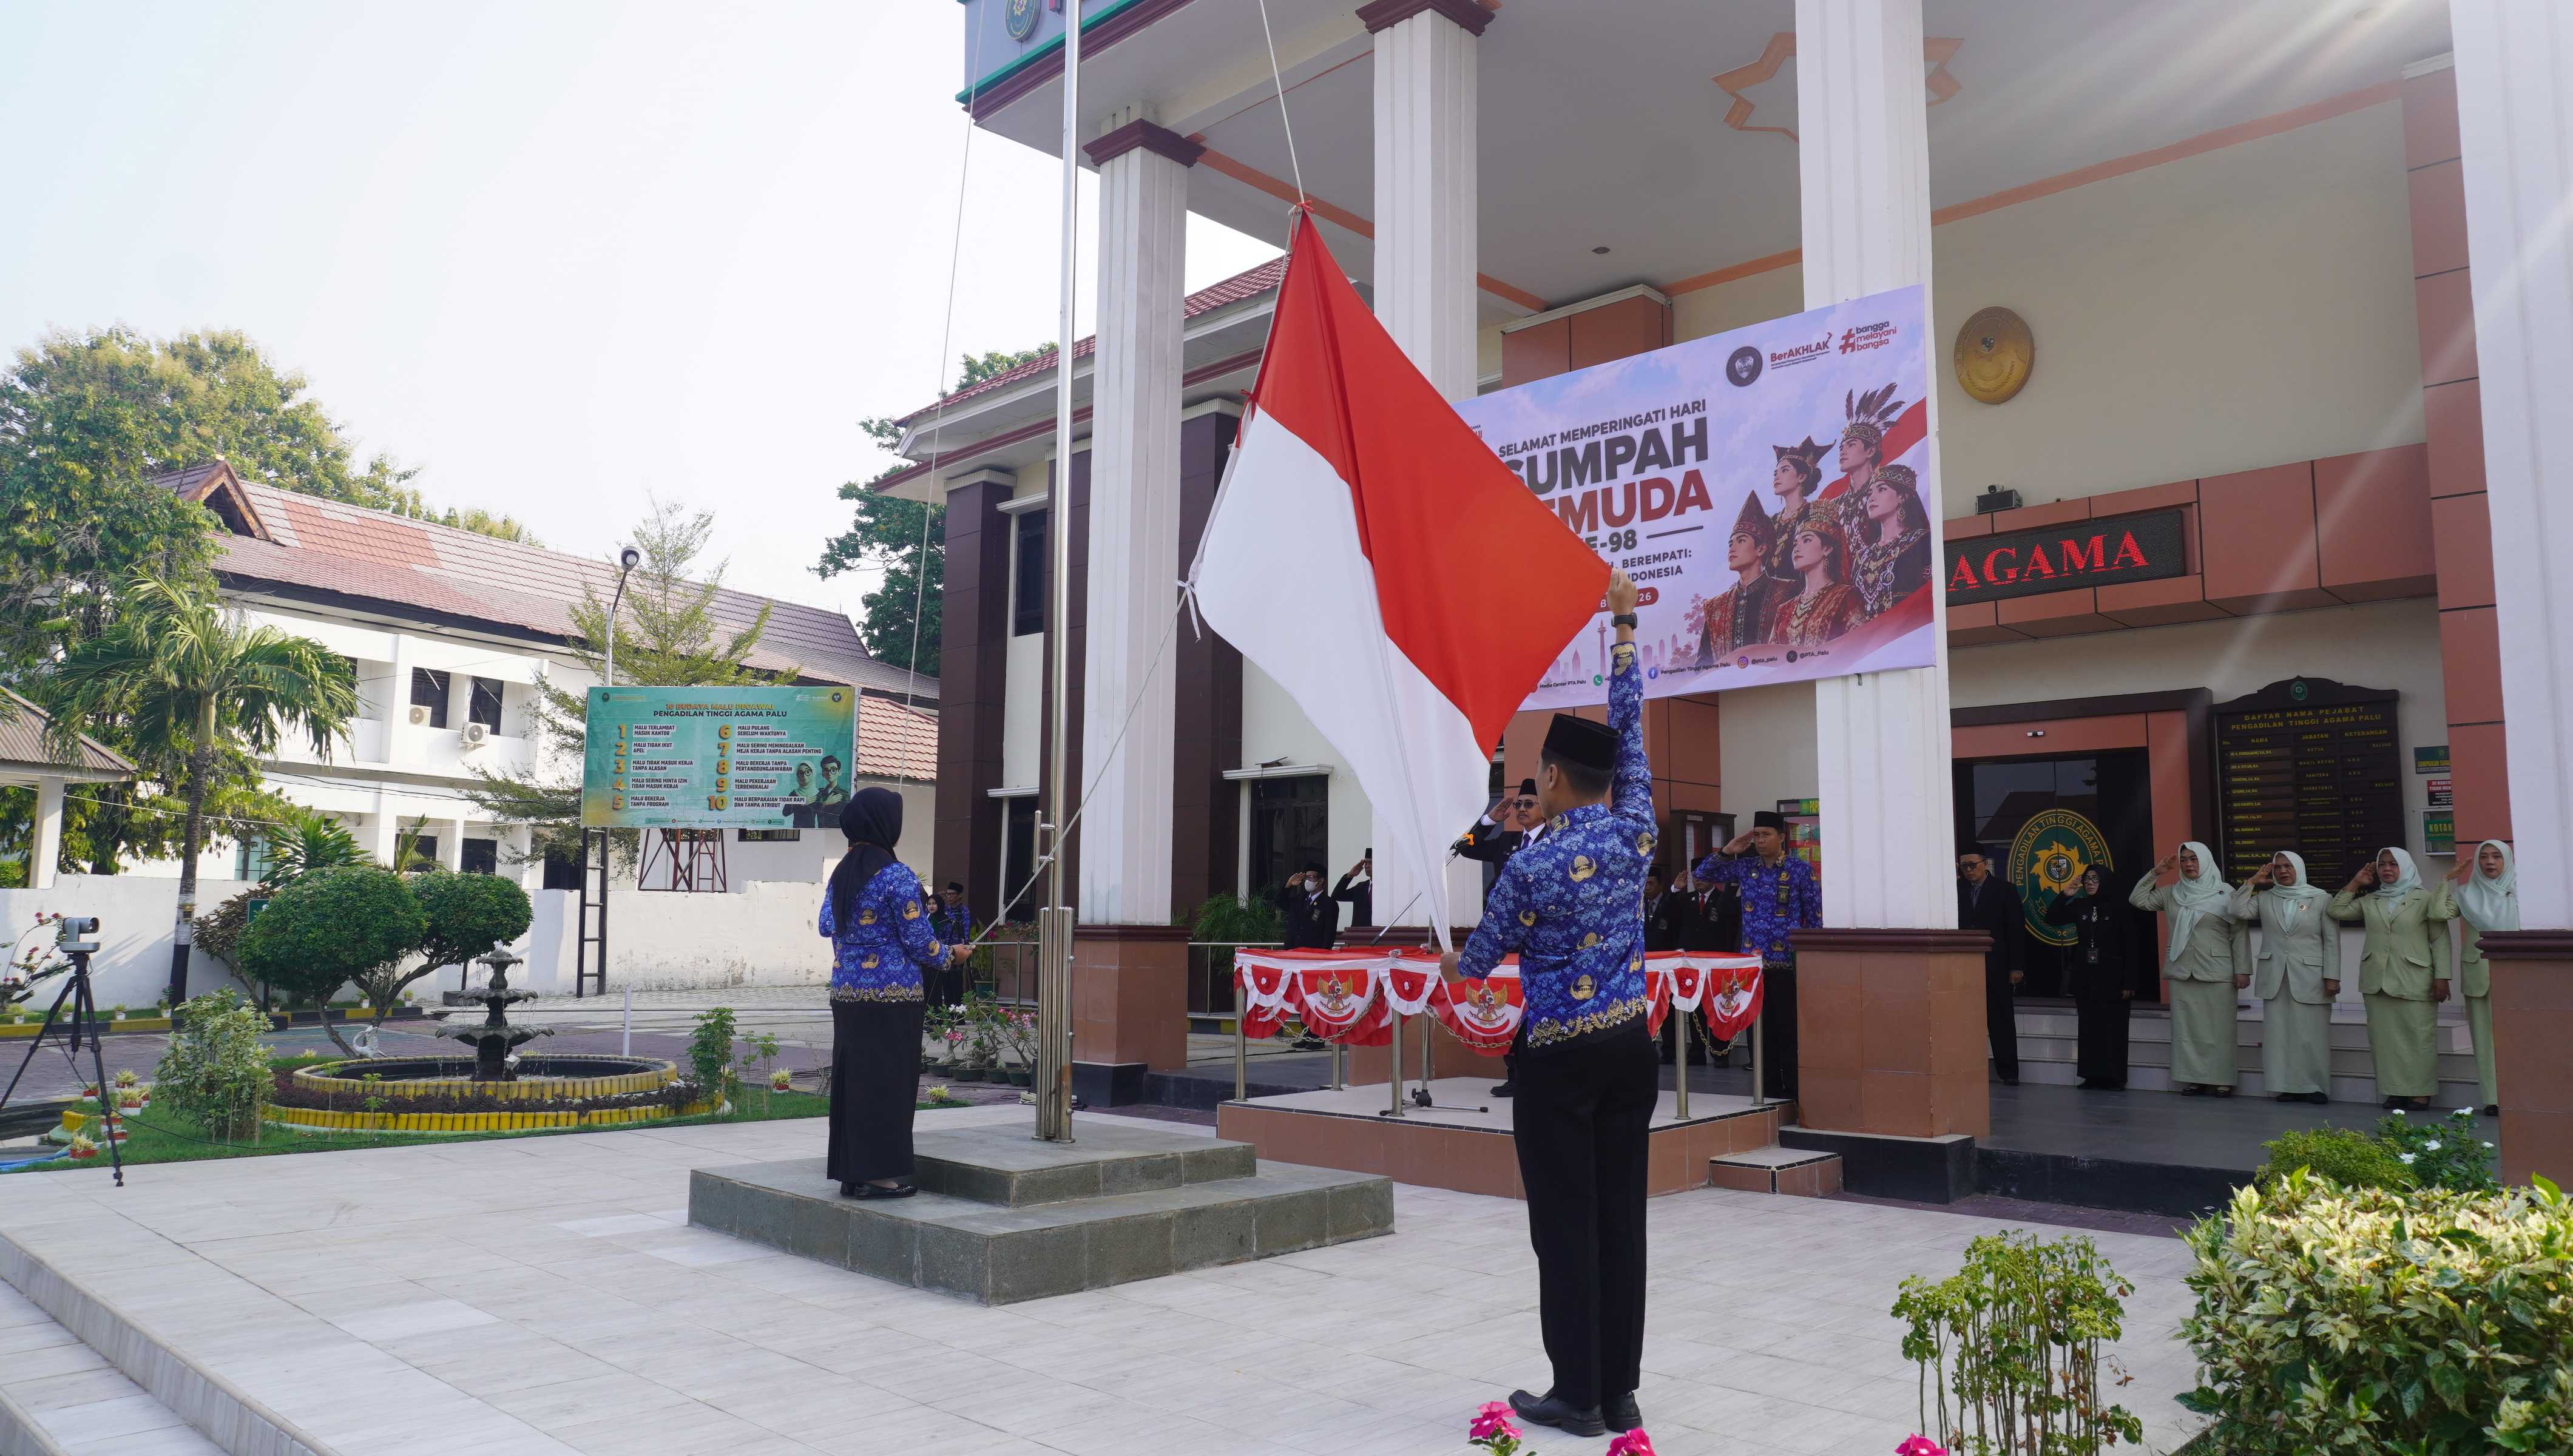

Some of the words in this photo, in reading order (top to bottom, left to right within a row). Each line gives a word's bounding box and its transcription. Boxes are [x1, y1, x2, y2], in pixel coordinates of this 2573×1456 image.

[1856, 320, 1890, 334] bangga
[1856, 326, 1897, 342] melayani
[1771, 340, 1830, 362] BerAKHLAK
[1857, 338, 1889, 351] bangsa
[1499, 433, 1557, 457] SELAMAT
[1560, 408, 1666, 444] MEMPERINGATI
[1670, 399, 1706, 419] HARI
[1542, 469, 1714, 534] MUDA
[1622, 548, 1692, 568] BEREMPATI:
[1947, 530, 2151, 592] AGAMA
[1638, 592, 1651, 602] 26
[1661, 667, 1686, 675] Pengadilan
[2244, 713, 2282, 721] DAFTAR
[2319, 706, 2364, 715] PEJABAT
[2231, 721, 2284, 730] PENGADILAN
[2323, 716, 2355, 724] AGAMA
[618, 724, 627, 738] 1
[719, 724, 731, 739] 6
[615, 741, 627, 755] 2
[718, 742, 729, 757] 7
[615, 759, 626, 774] 3
[717, 759, 729, 775] 8
[612, 777, 627, 791] 4
[716, 777, 729, 793] 9
[613, 795, 624, 810] 5
[708, 796, 728, 811] 10
[2015, 826, 2040, 886] PENGADILAN
[2040, 815, 2077, 827] TINGGI
[2077, 824, 2100, 858] AGAMA
